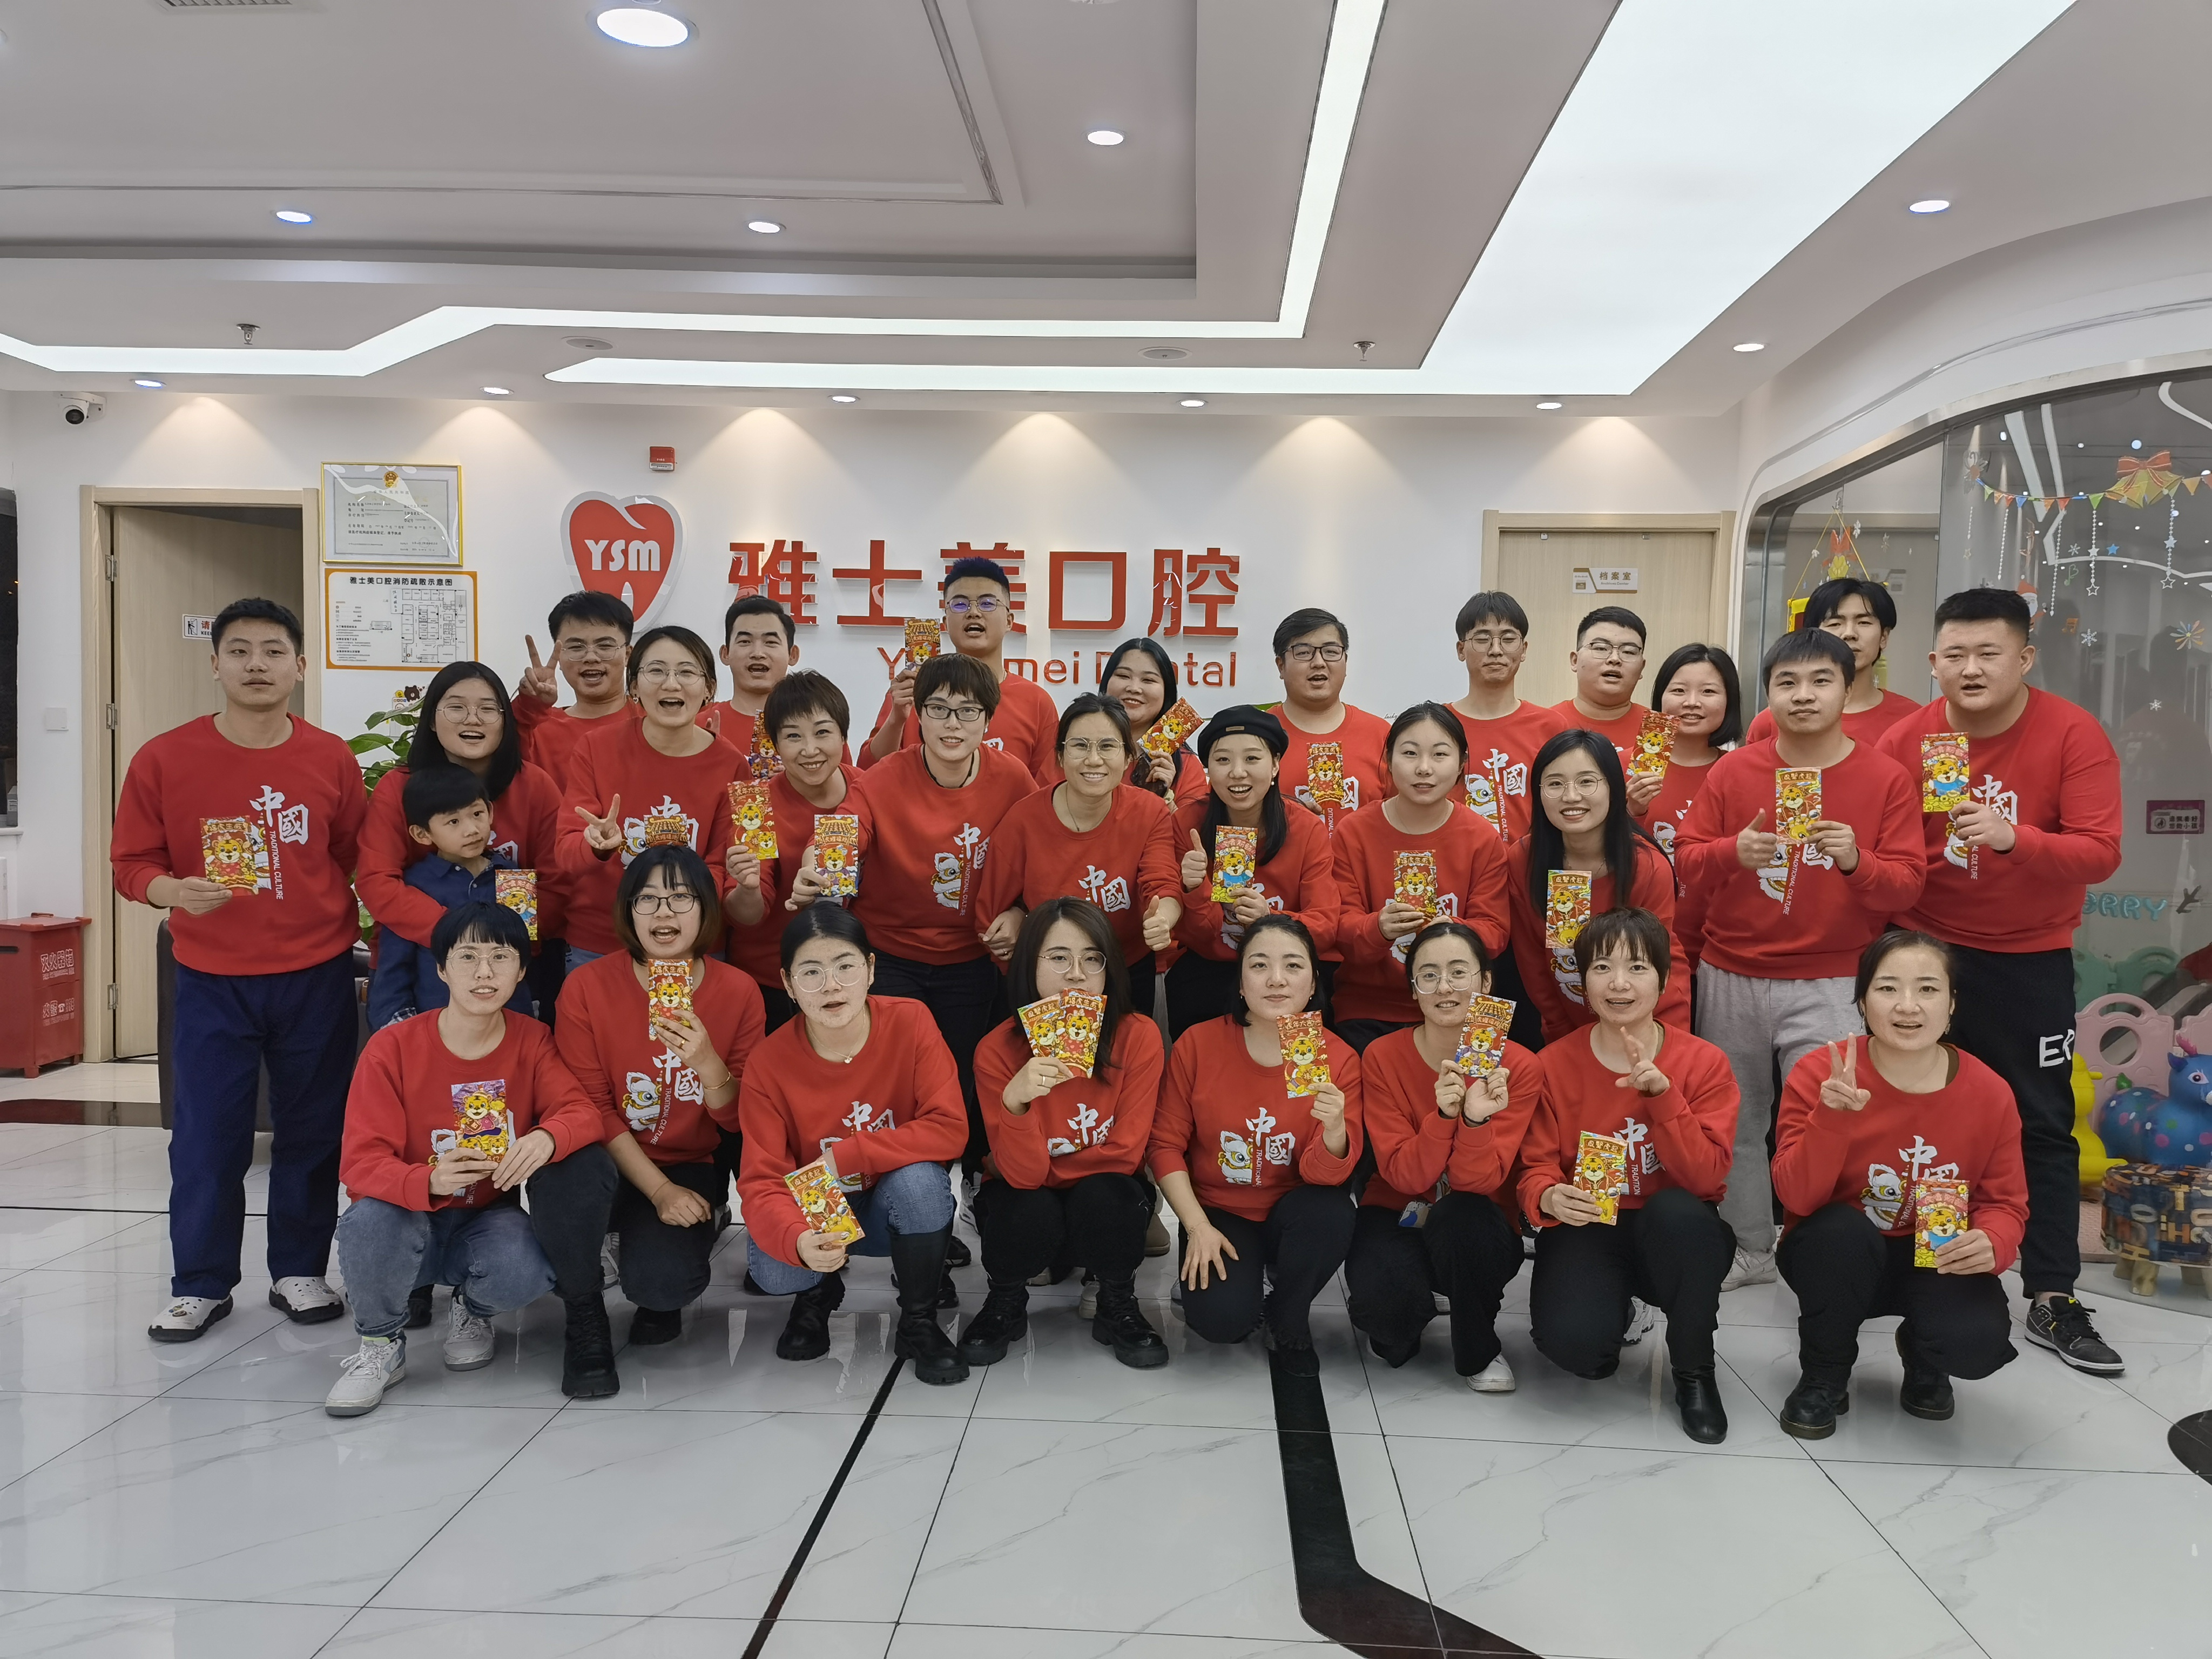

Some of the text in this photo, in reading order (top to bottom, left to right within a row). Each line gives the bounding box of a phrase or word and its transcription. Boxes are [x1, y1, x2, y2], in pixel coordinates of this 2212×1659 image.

[584, 539, 661, 571] YSM
[1600, 571, 1631, 581] 档案室
[350, 577, 453, 586] 雅士美口腔消防疏散示意图
[1482, 748, 1528, 797] 中國
[249, 785, 309, 845] 中國
[1497, 785, 1506, 818] TRADITIONAL
[1972, 774, 2018, 825] 中國
[269, 830, 284, 900] TRADITIONAL CULTURE
[963, 861, 972, 894] TRADITIONAL
[1078, 865, 1131, 912] 中國
[1783, 851, 1800, 916] TRADITIONAL CULTURE
[1971, 854, 1979, 880] CULTURE
[41, 949, 75, 973] 灭火器箱
[652, 1047, 704, 1105] 中國
[650, 1087, 671, 1145] TRADITIONAL CULTURE
[1245, 1107, 1296, 1166] 中國
[1631, 1164, 1641, 1195] TRADITION
